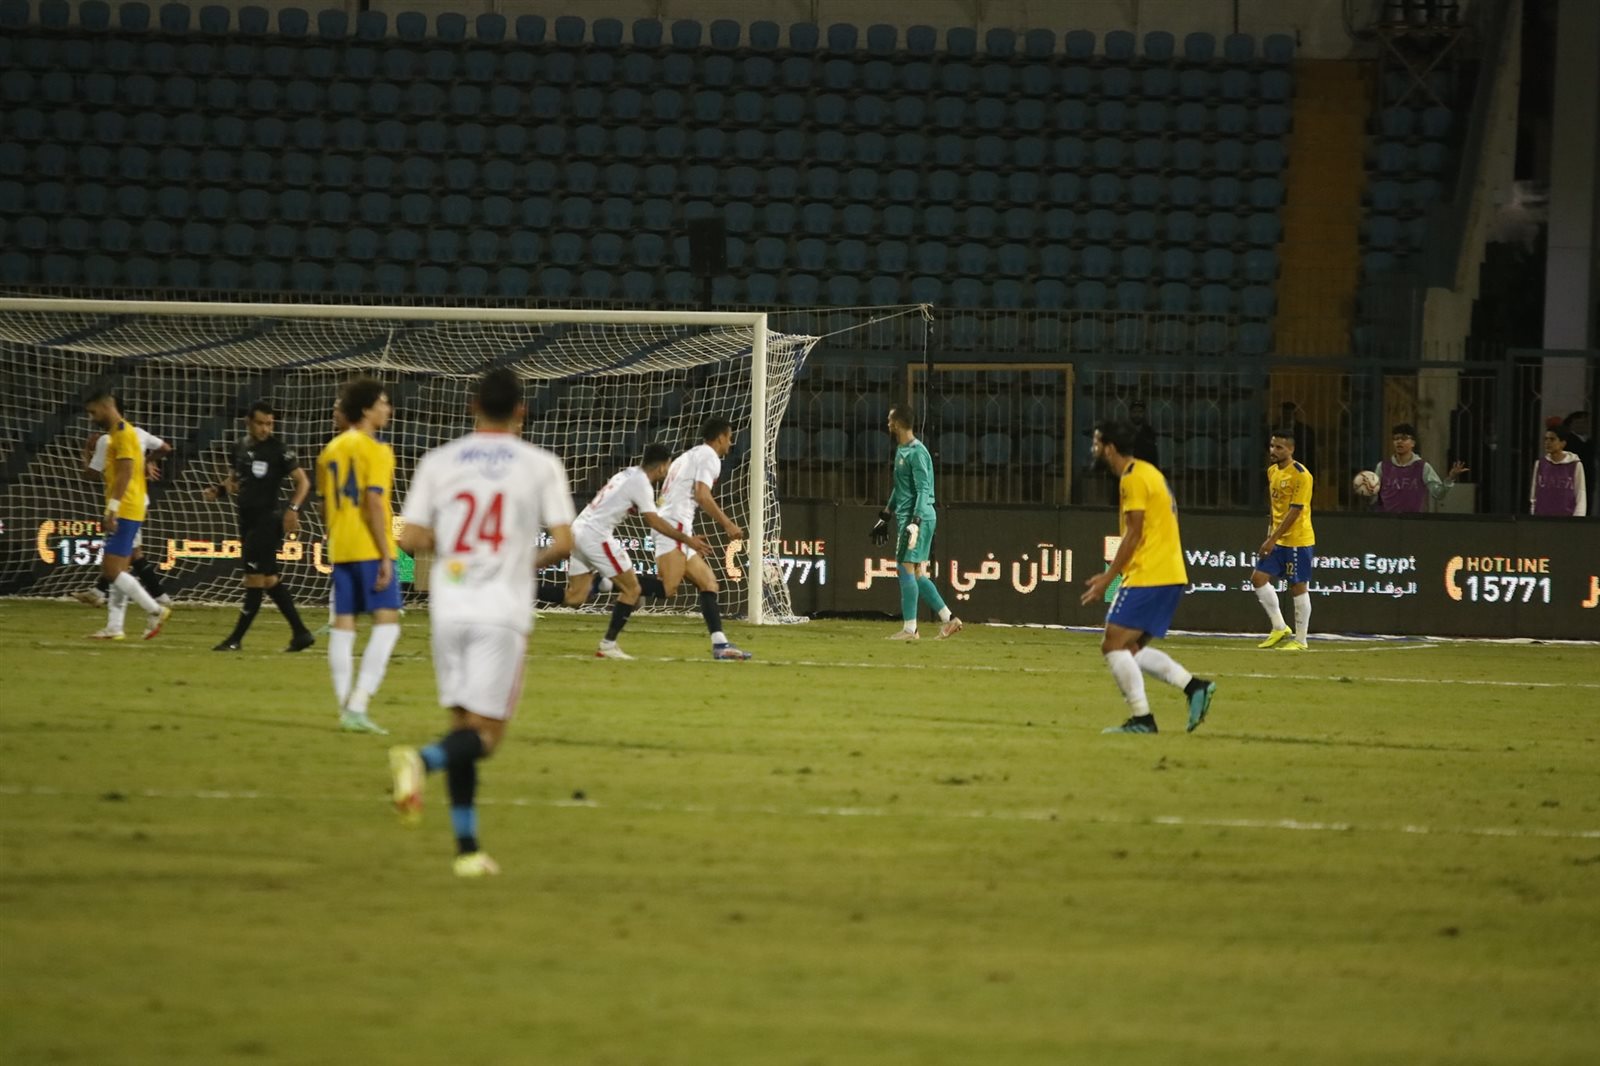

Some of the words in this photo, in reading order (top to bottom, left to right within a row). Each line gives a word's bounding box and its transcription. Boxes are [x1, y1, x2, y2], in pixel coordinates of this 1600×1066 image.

[328, 456, 360, 510] 14
[58, 520, 106, 537] HOTL
[453, 491, 504, 554] 24
[57, 539, 106, 566] 157
[158, 538, 242, 571] مصر
[746, 540, 826, 556] TLINE
[1184, 549, 1237, 568] Wafa
[1239, 551, 1260, 568] Li
[1311, 555, 1360, 569] rance
[1363, 553, 1417, 574] Egypt
[745, 558, 826, 586] 771
[949, 552, 1000, 601] في
[1465, 557, 1551, 573] HOTLINE
[1184, 582, 1227, 596] مصر
[1466, 575, 1552, 604] 15771
